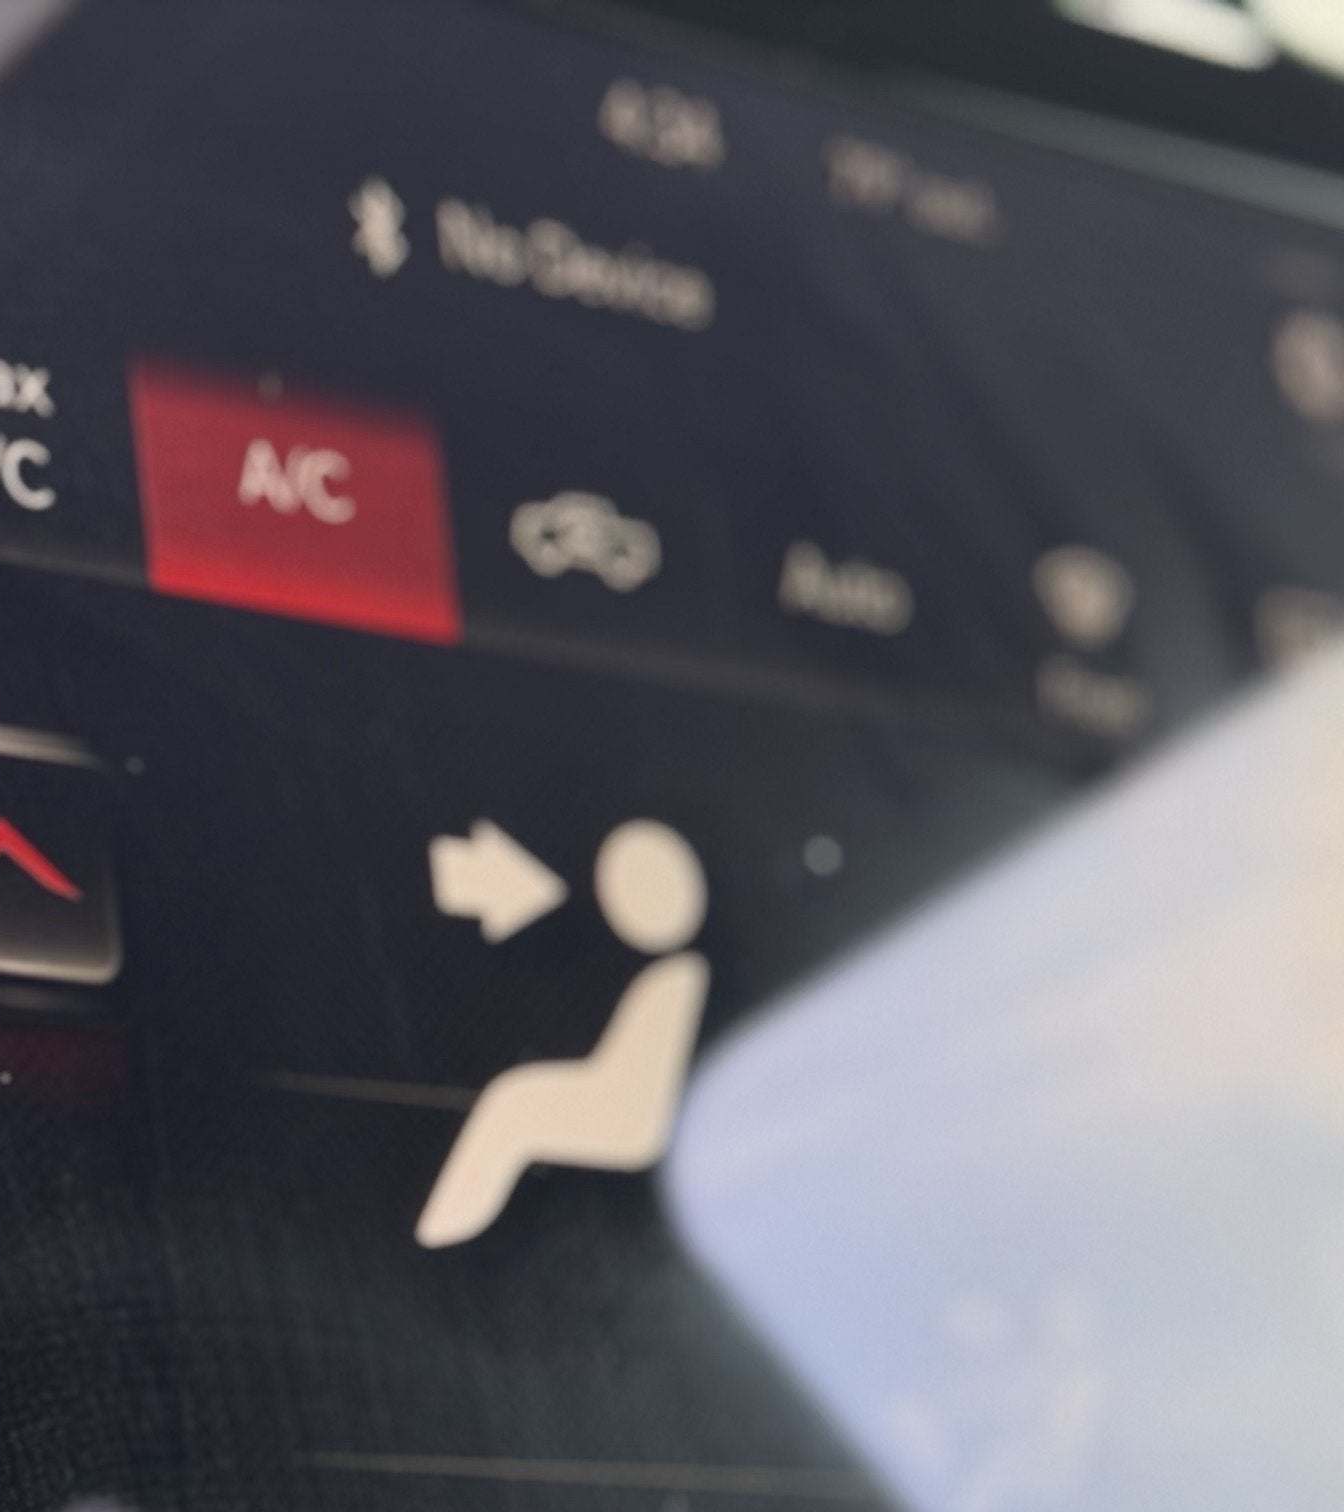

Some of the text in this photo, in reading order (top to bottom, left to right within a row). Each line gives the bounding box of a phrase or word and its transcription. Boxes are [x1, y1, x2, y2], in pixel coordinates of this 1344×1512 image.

[436, 198, 714, 330] No Device
[238, 440, 357, 525] A/C
